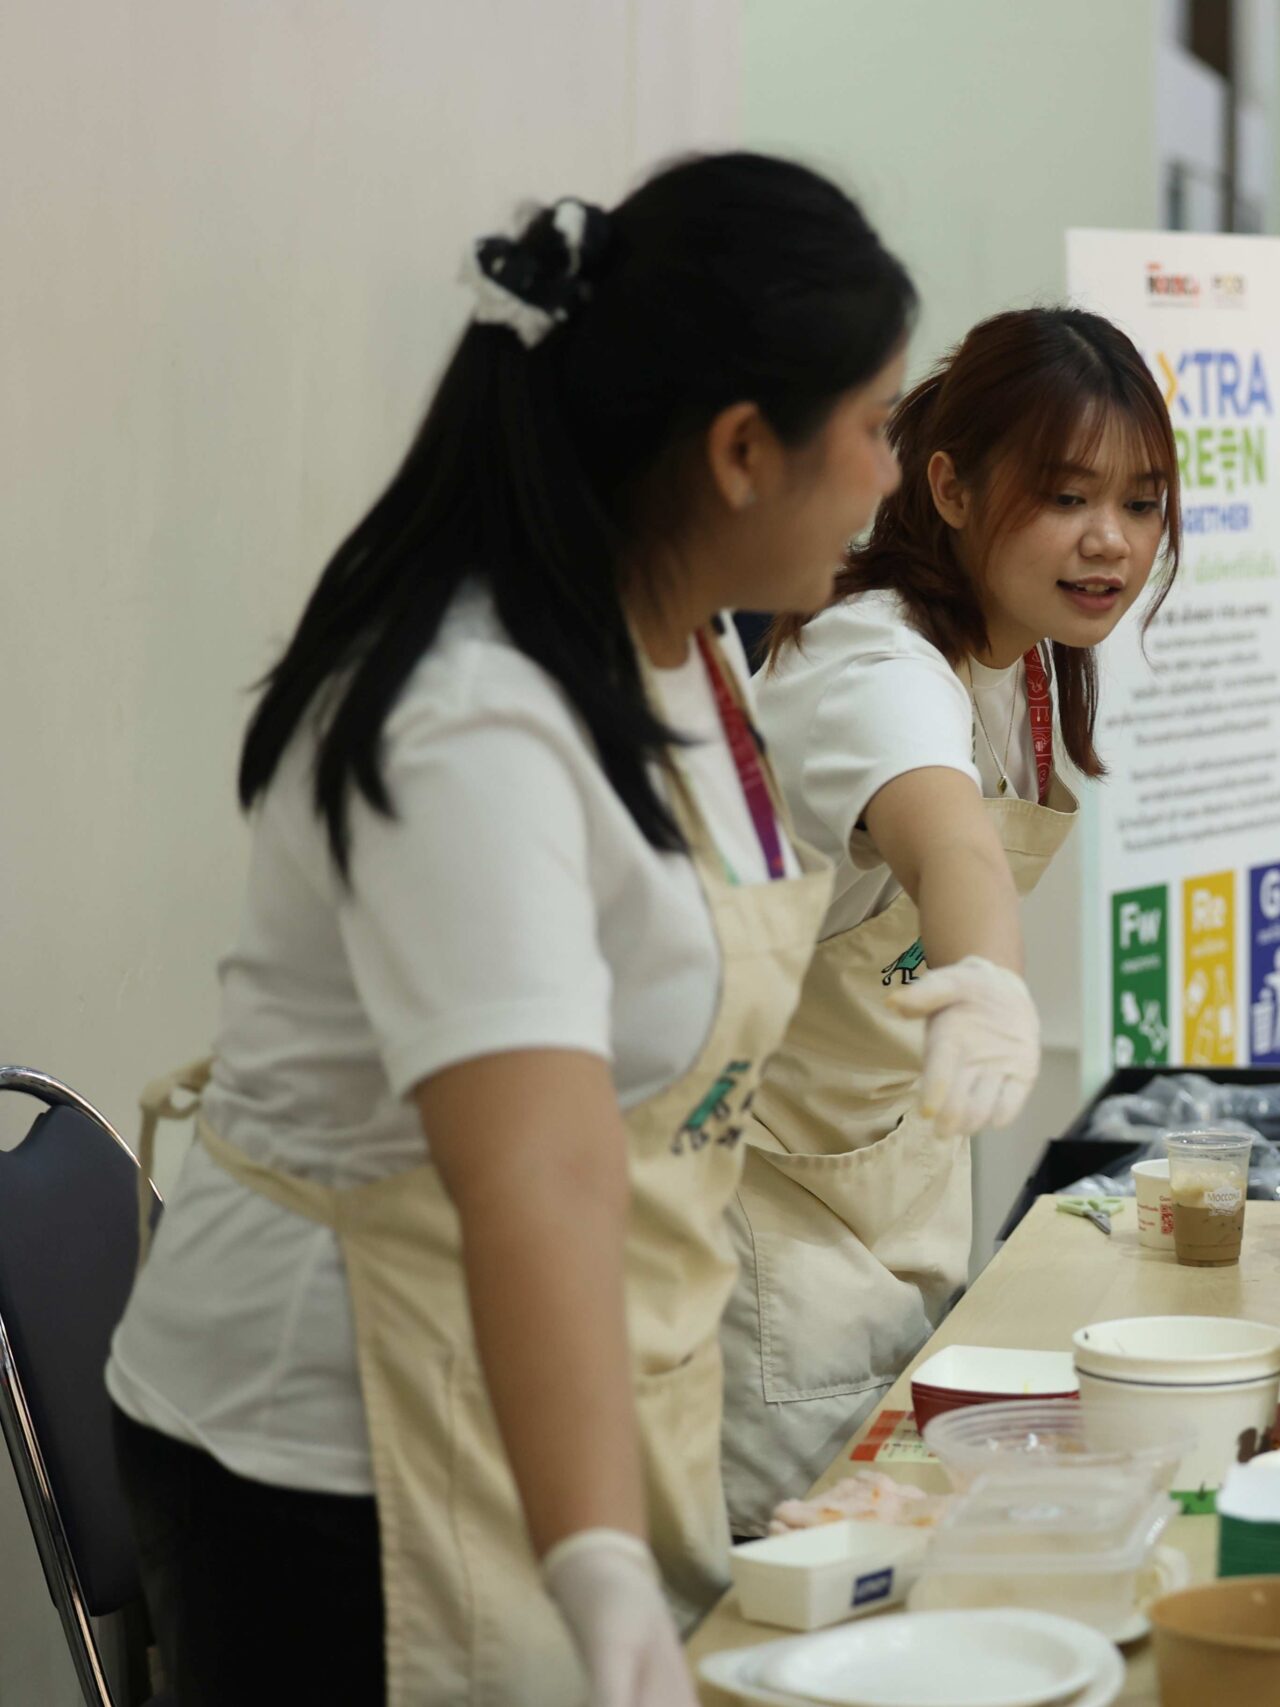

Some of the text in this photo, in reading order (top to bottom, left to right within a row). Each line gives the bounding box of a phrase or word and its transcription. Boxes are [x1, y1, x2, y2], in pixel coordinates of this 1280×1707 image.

[1157, 350, 1273, 418] XTRA
[1174, 427, 1267, 493] REEN
[1181, 503, 1251, 533] GETHER
